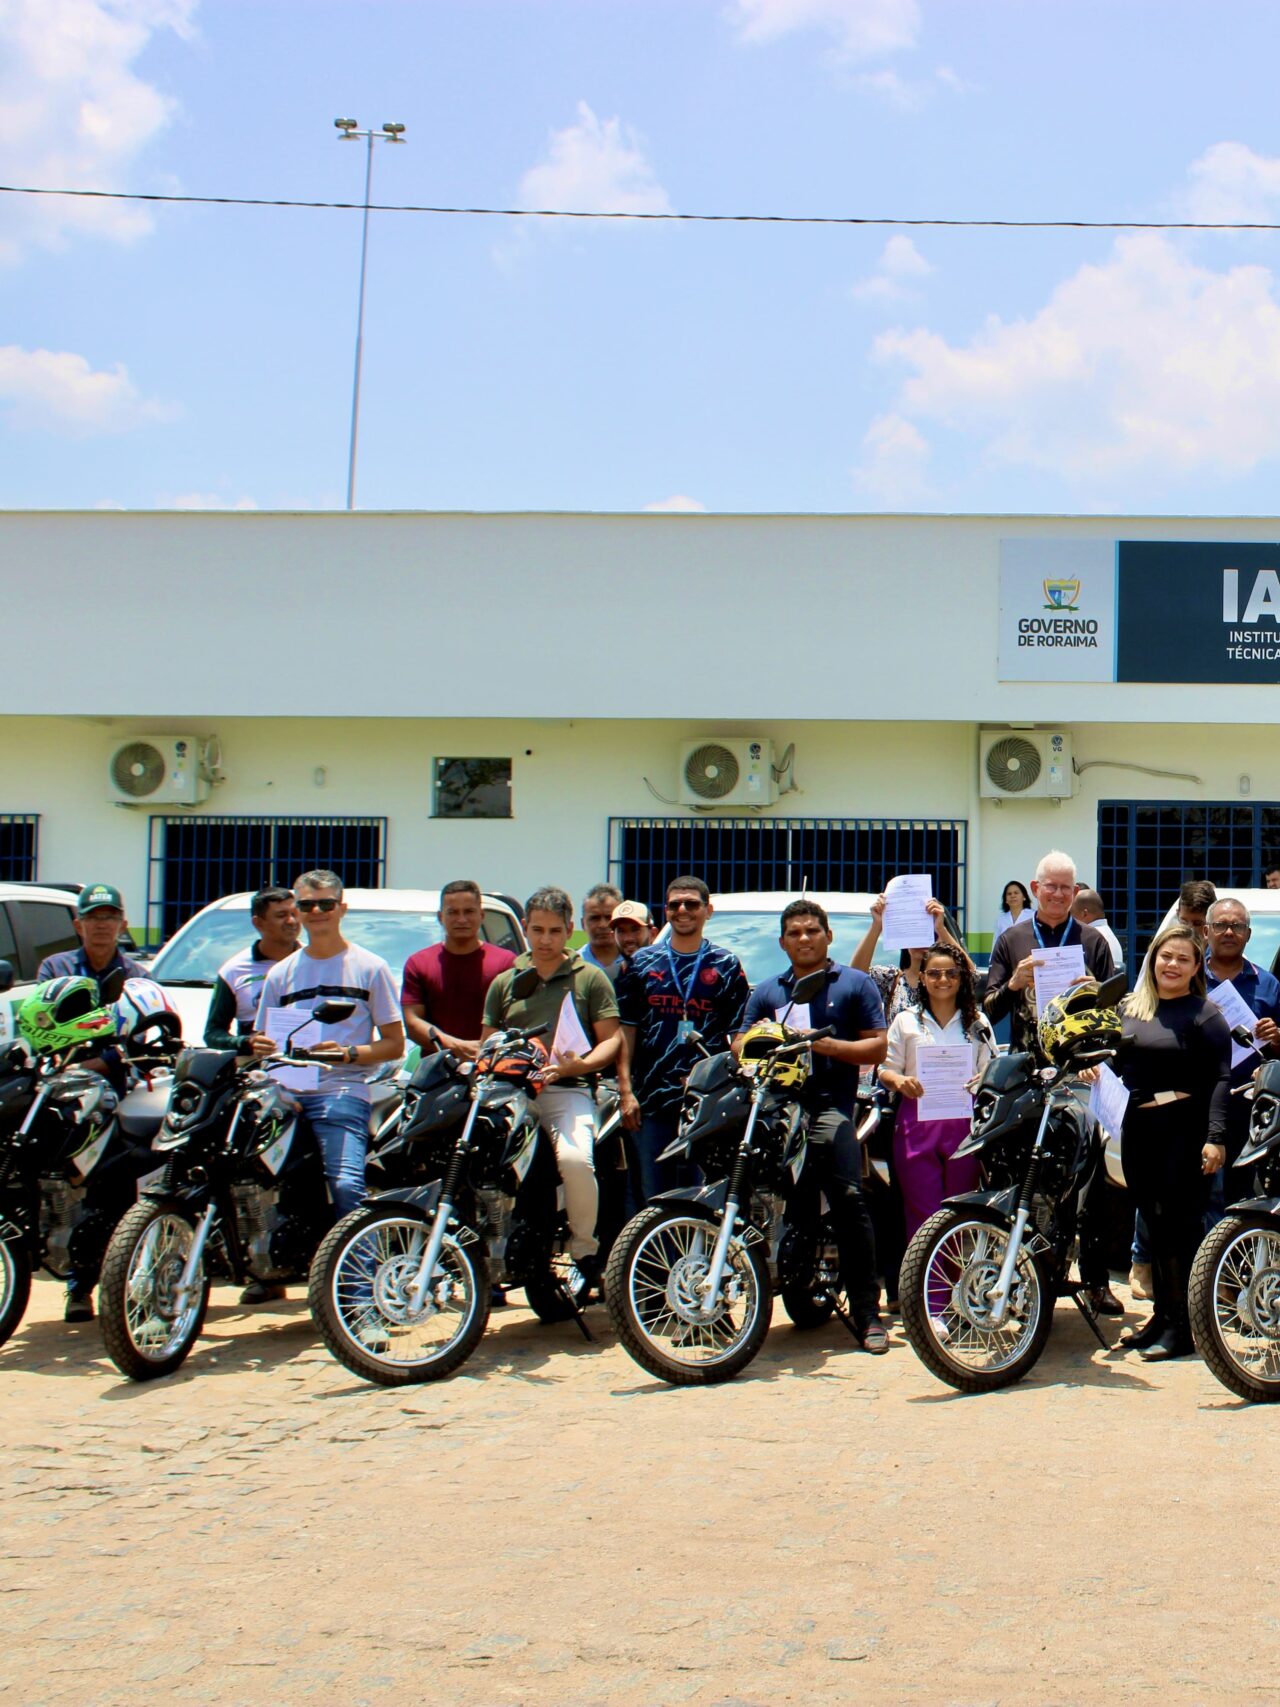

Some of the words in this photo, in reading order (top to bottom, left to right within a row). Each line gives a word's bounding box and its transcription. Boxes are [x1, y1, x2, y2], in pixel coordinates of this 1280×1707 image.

[1018, 618, 1098, 634] GOVERNO
[1018, 635, 1035, 646] DE
[1037, 635, 1098, 647] RORAIMA
